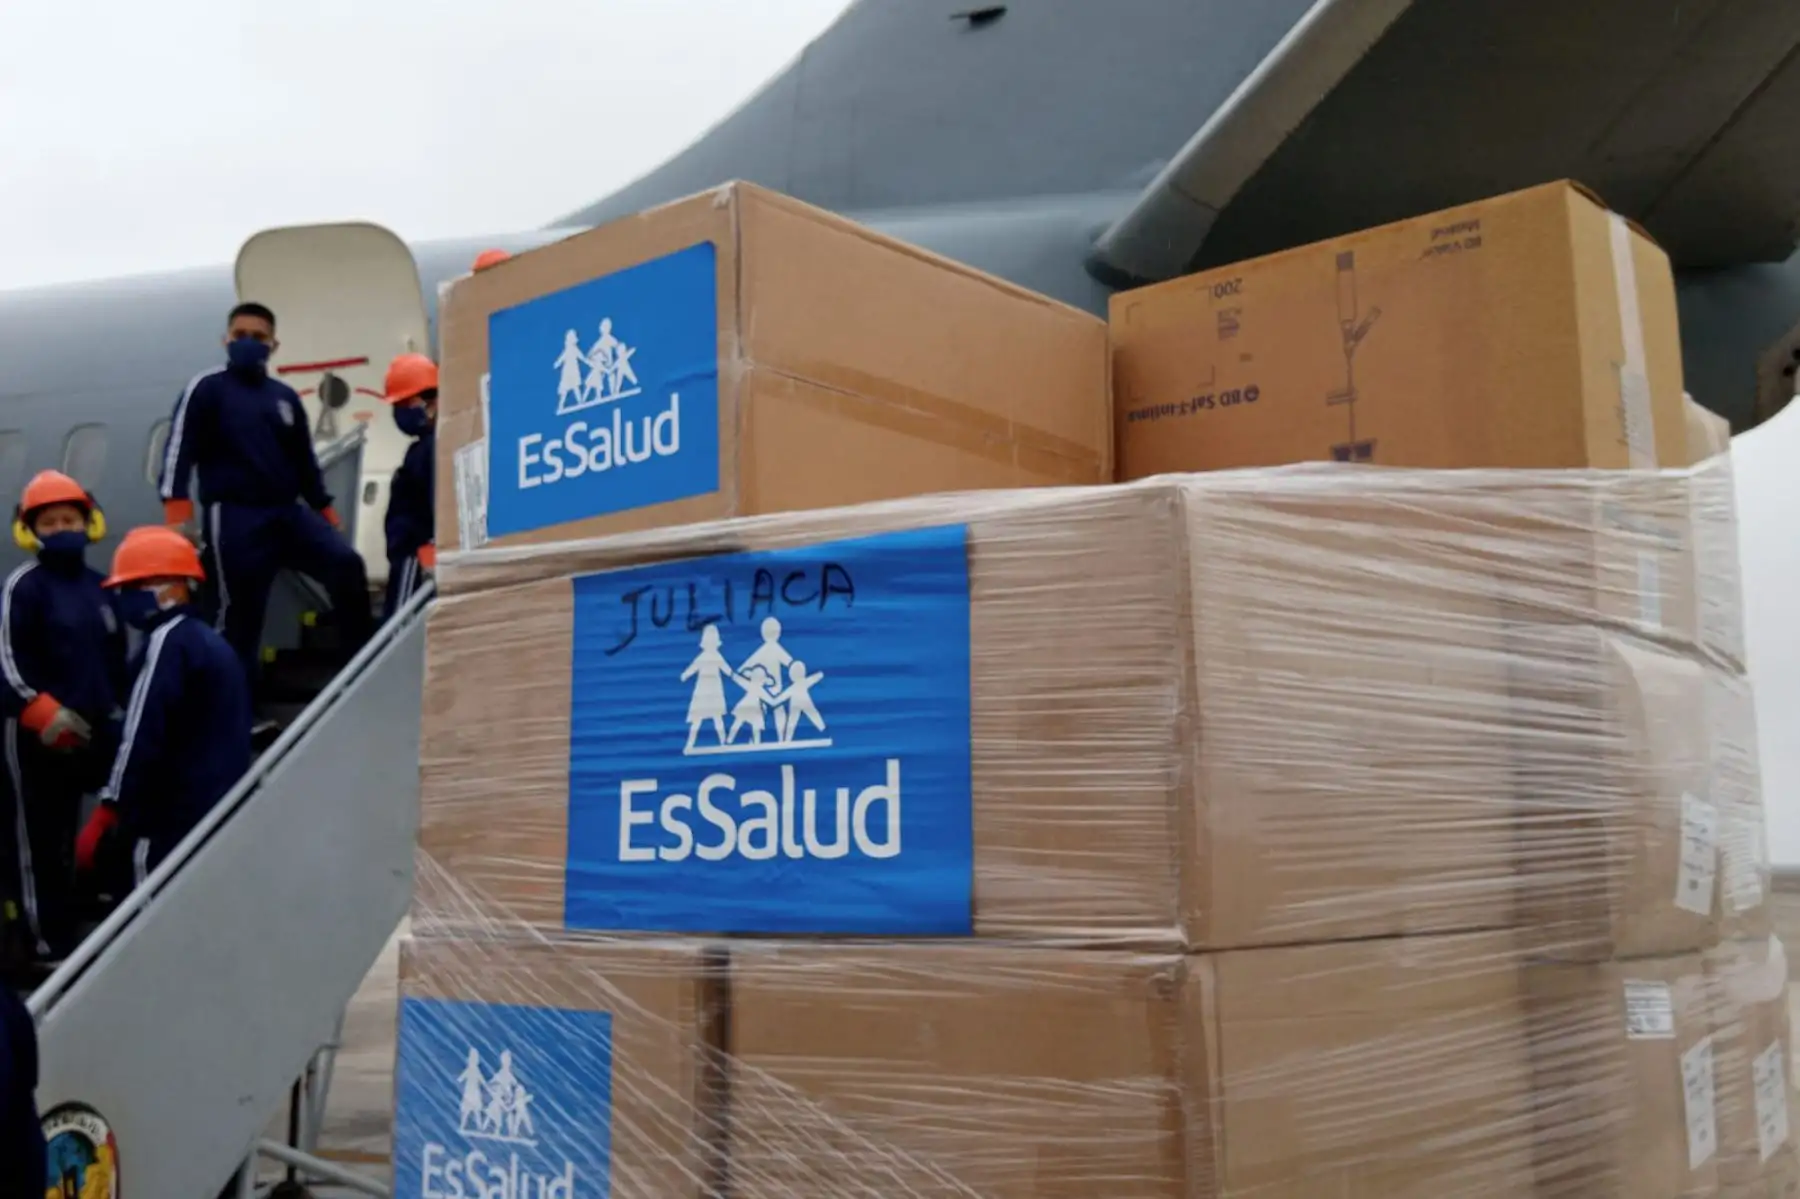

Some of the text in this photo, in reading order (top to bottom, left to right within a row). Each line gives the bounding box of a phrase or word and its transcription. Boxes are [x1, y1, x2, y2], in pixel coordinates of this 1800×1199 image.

[518, 394, 680, 489] EsSalud
[1220, 388, 1242, 408] BD
[604, 563, 856, 656] JULIACA
[618, 758, 901, 862] EsSalud
